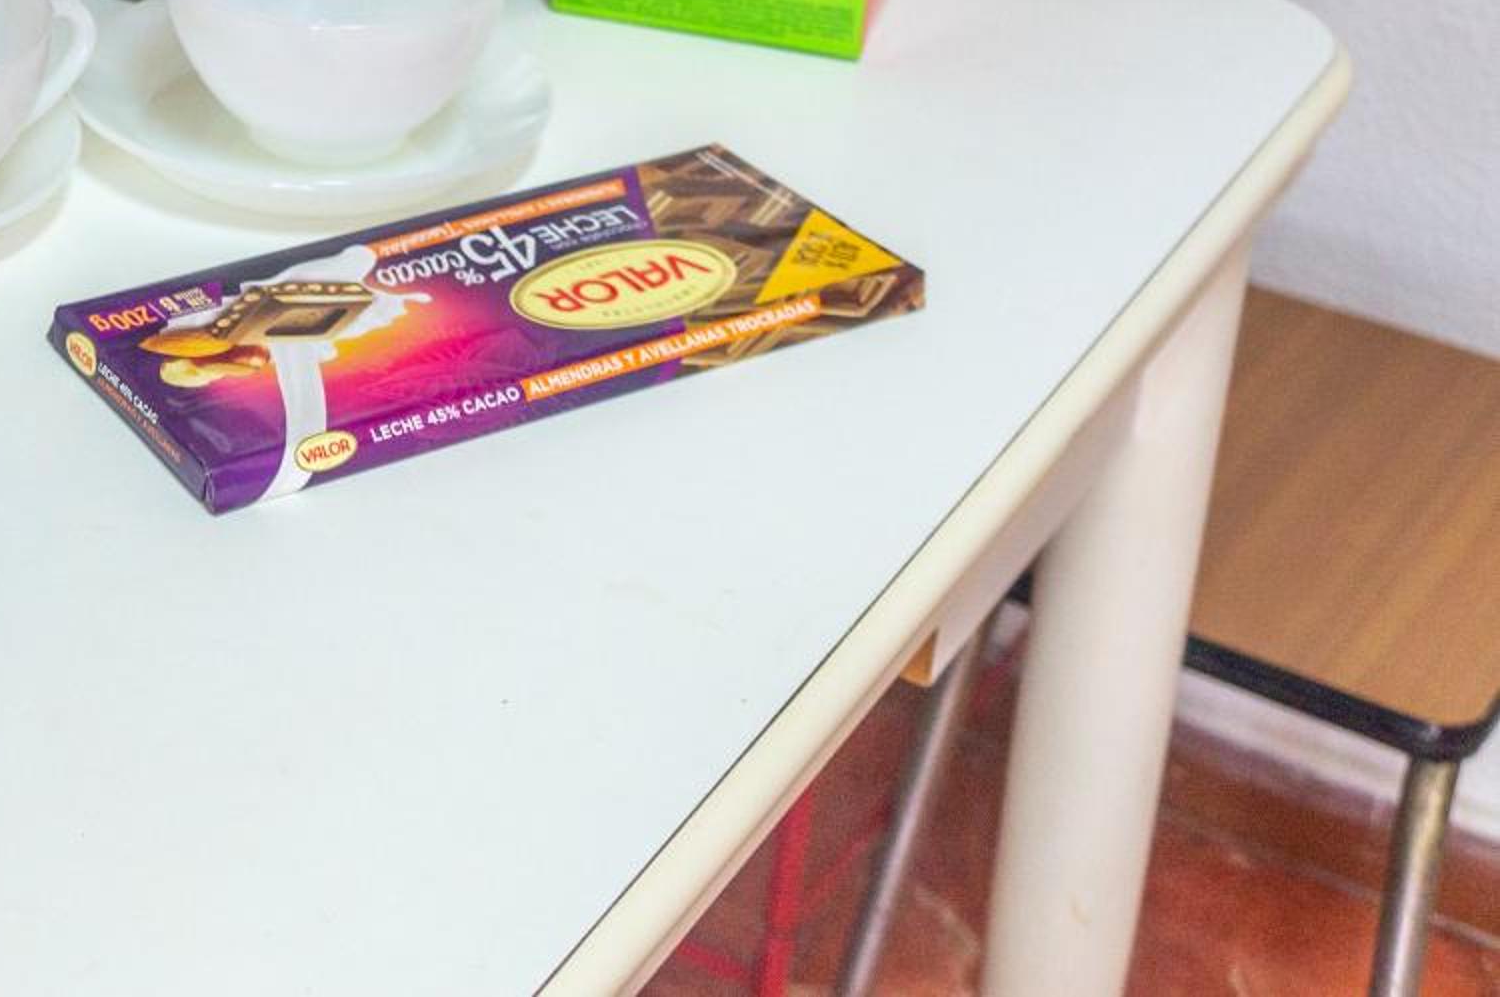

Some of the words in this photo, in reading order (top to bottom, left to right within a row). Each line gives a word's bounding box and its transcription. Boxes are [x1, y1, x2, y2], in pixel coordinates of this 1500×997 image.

[529, 204, 640, 246] LECHE
[376, 249, 466, 286] cacao
[534, 255, 712, 312] VALOR
[528, 359, 622, 396] ALMENDRAS
[623, 353, 636, 368] Y
[639, 329, 727, 361] AVELLANAS
[728, 299, 817, 337] TROCEADAS
[369, 414, 426, 443] LECHE
[426, 405, 462, 427] 45%
[463, 387, 521, 415] CACAO
[301, 438, 351, 465] VALOR
